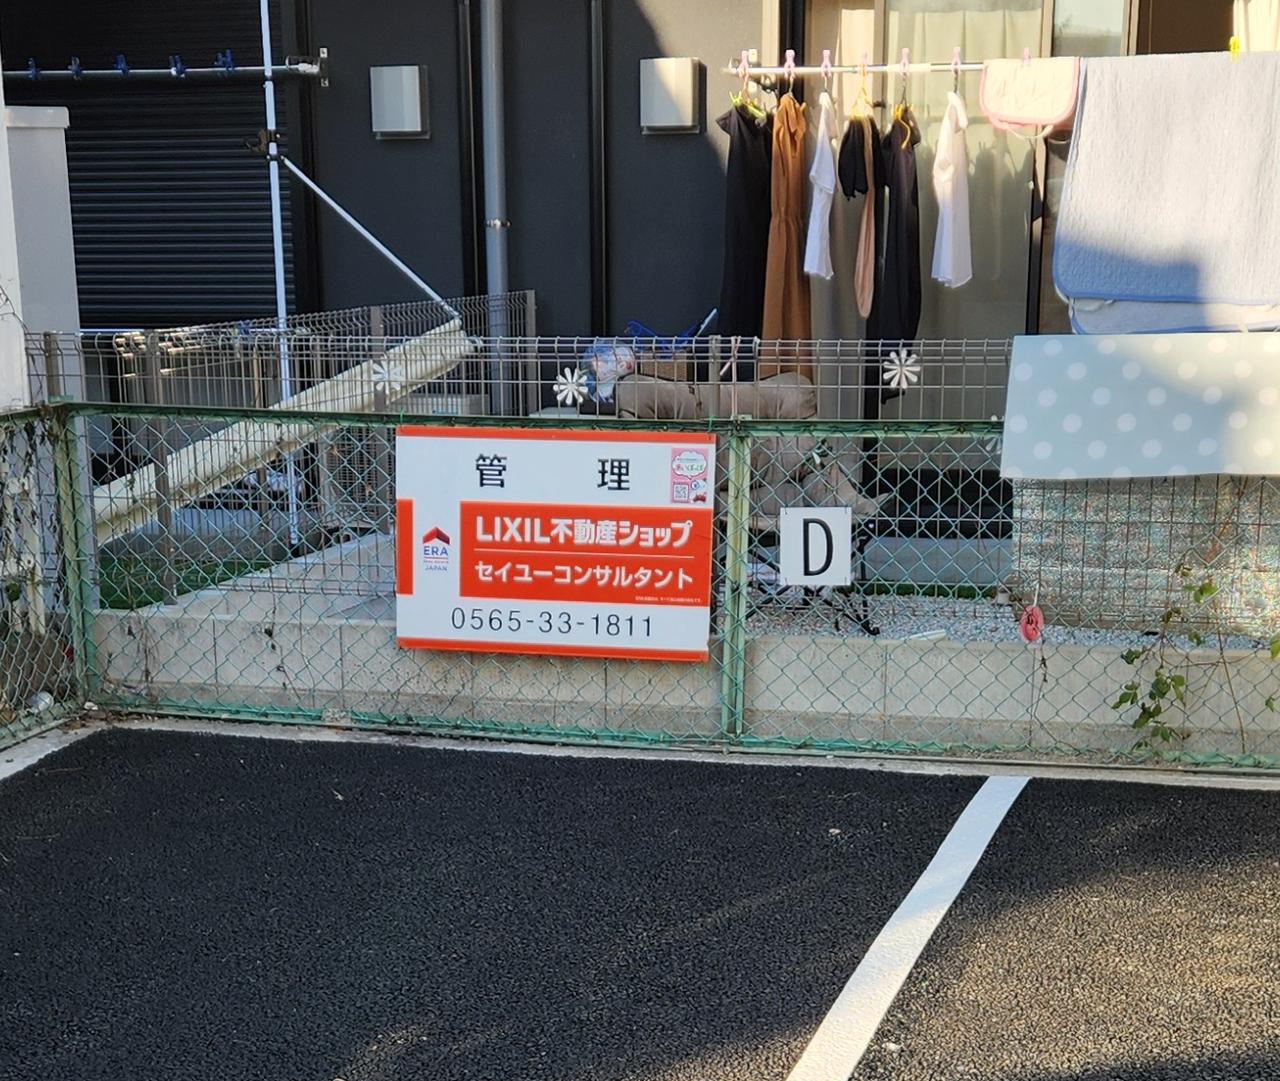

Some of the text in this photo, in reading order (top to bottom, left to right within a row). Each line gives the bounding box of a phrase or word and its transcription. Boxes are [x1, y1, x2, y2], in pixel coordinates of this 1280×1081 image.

[476, 453, 630, 491] 管理
[475, 515, 694, 548] LIXIL不動産ショップ
[803, 517, 833, 576] D
[423, 545, 449, 557] ERA
[474, 560, 694, 590] セイユーコンサルタント
[451, 606, 652, 637] 0565-33-1811
